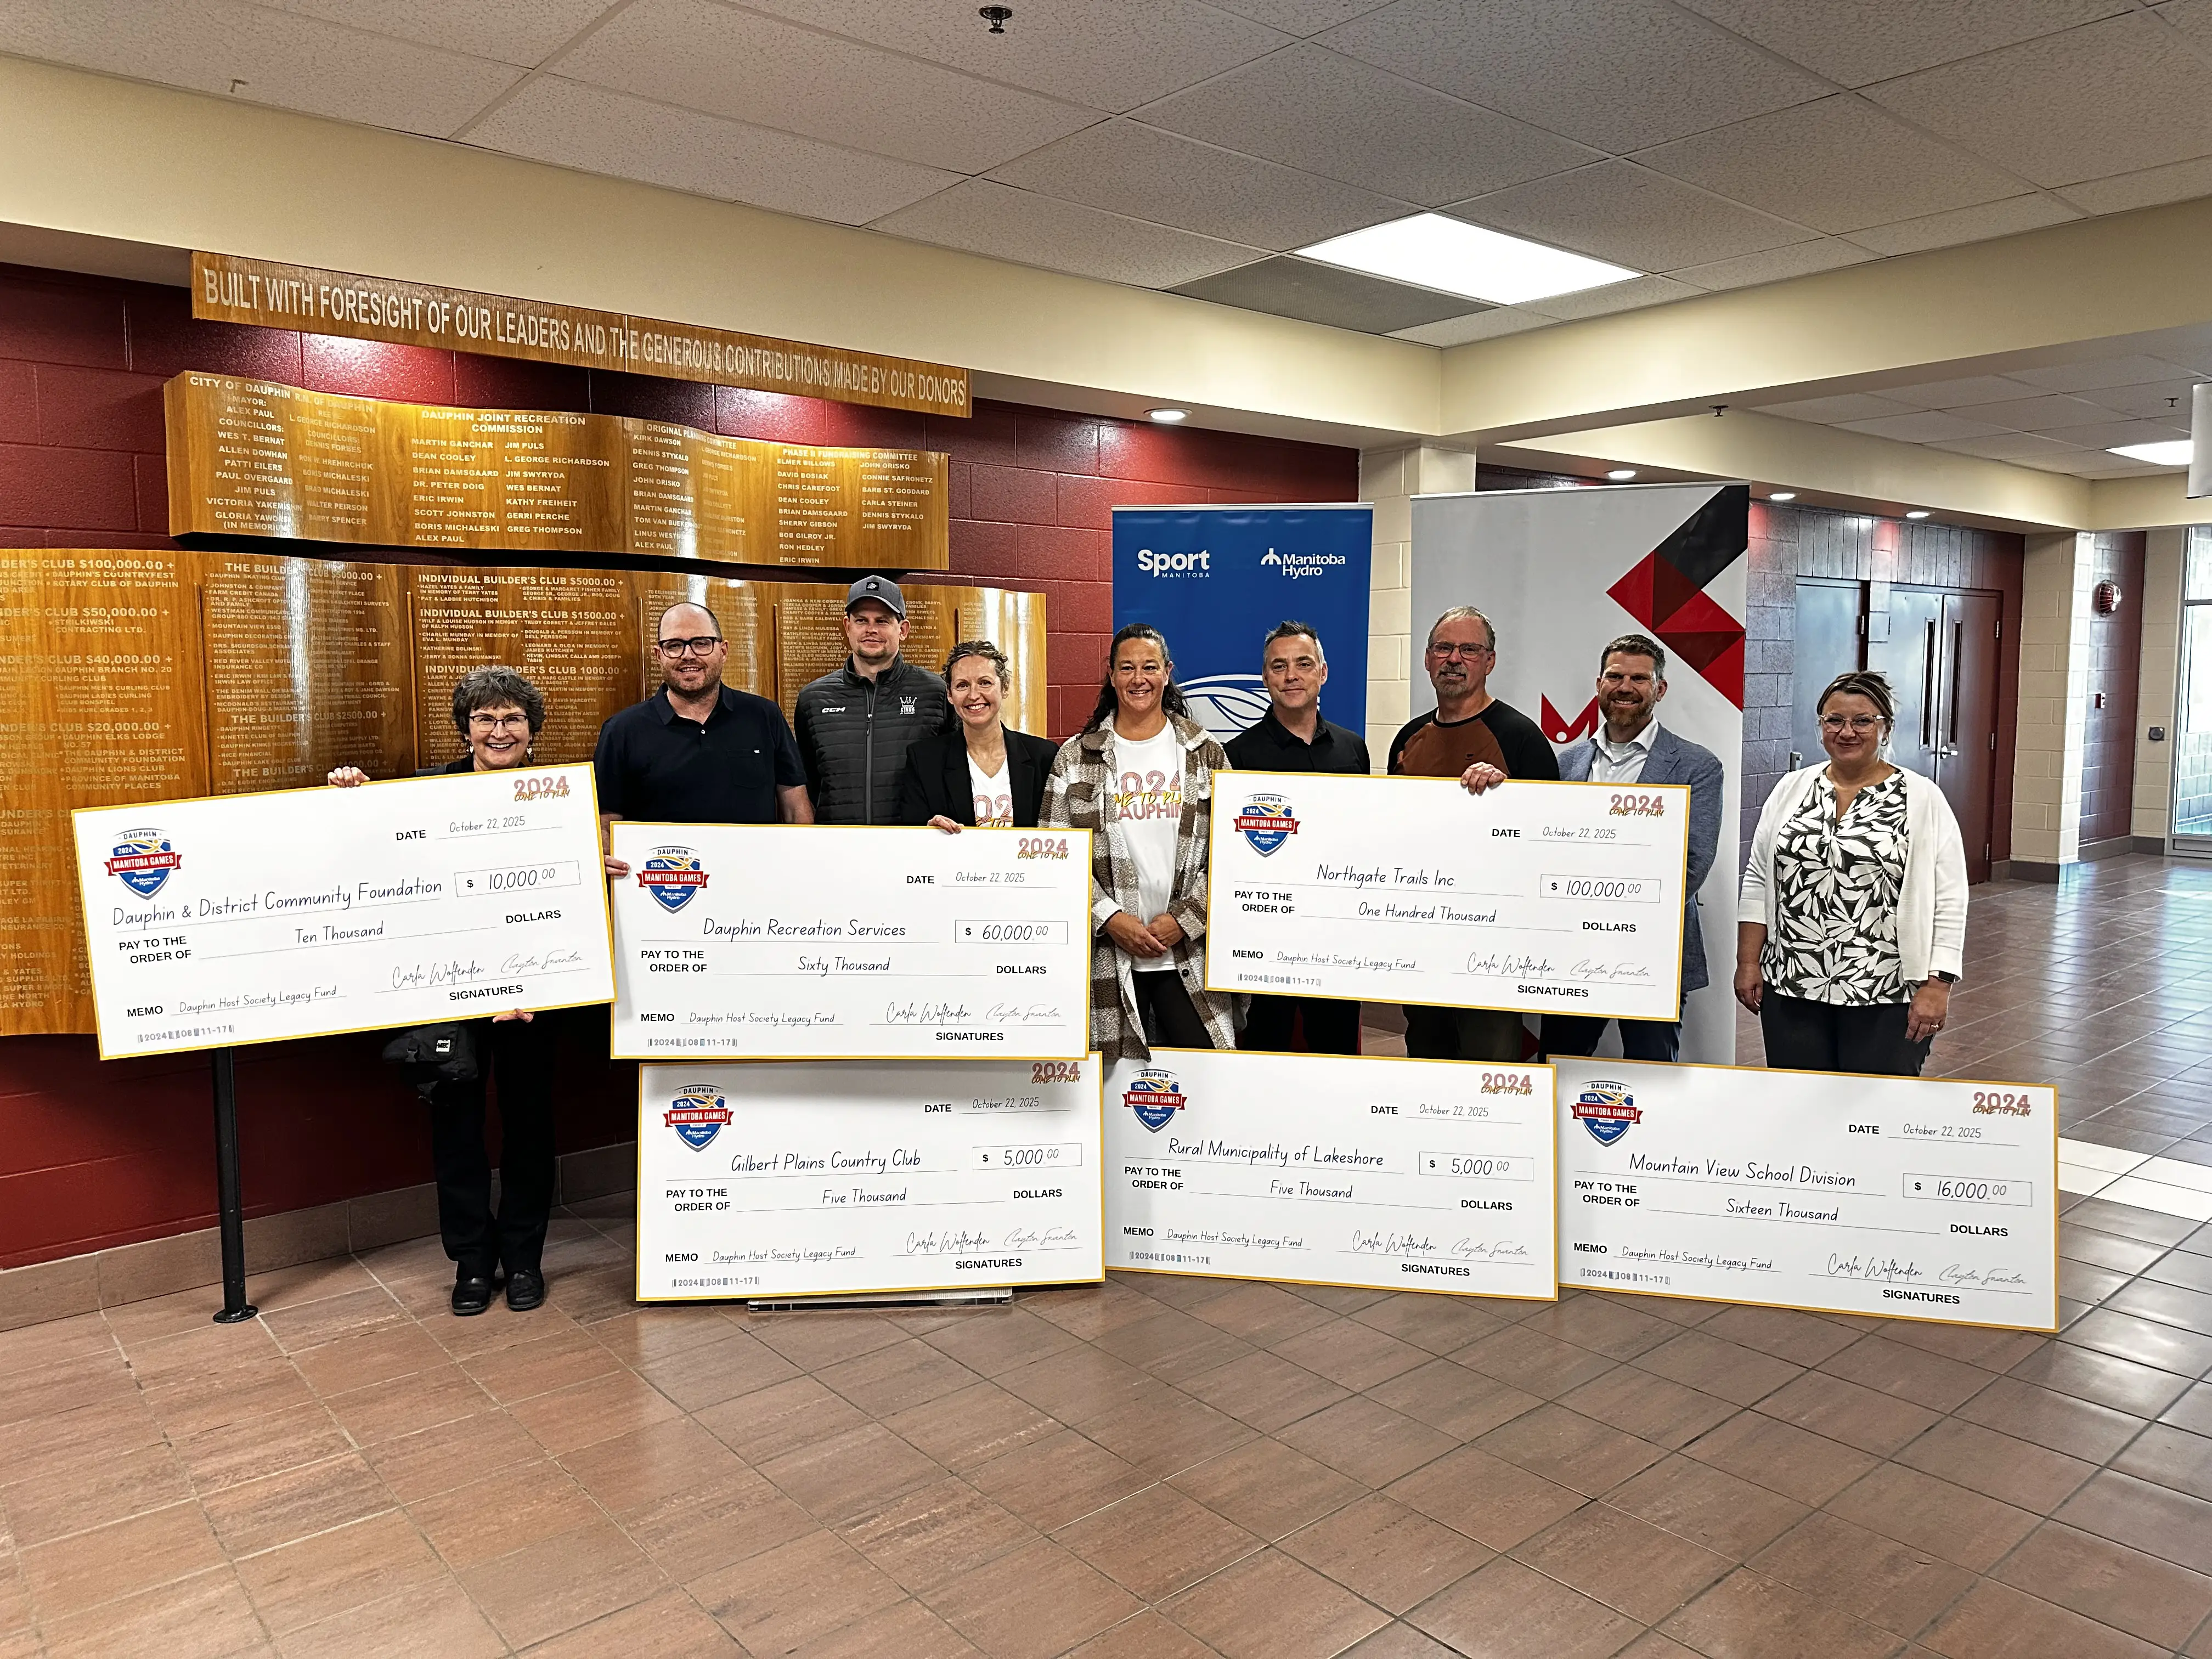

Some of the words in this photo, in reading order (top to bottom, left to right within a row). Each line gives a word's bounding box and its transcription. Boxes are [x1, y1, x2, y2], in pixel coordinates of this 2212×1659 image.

[204, 269, 260, 310] BUILT
[266, 276, 314, 317] WITH
[320, 285, 422, 330] FORESIGHT
[428, 301, 450, 334] OF
[455, 306, 491, 340] OUR
[496, 312, 569, 351] LEADERS
[574, 323, 605, 358] AND
[610, 326, 639, 360] THE
[643, 331, 721, 372] GENEROUS
[726, 343, 830, 387] CONTRIBUTIONS
[833, 362, 868, 392] MADE
[872, 366, 887, 394] BY
[890, 369, 915, 399] OUR
[918, 374, 965, 407] DONORS
[190, 376, 221, 388] CITY
[225, 381, 241, 390] OF
[246, 383, 290, 398] DAUPHIN
[226, 405, 251, 415] ALEX
[253, 409, 275, 419] PAUL
[421, 410, 474, 421] DAUPHIN
[477, 414, 511, 422] JOINT
[514, 414, 586, 425] RECREATION
[219, 418, 284, 432] COUNCILLORS:
[471, 424, 543, 433] COMMISSION
[218, 431, 239, 439] WES
[253, 435, 285, 445] BERNAT
[411, 438, 447, 447] MARTIN
[818, 450, 871, 459] FUNDRAISING
[873, 452, 918, 461] COMMITTEE
[224, 460, 251, 468] PATTI
[254, 462, 283, 471] EILERS
[656, 465, 689, 475] THOMPSON
[656, 479, 680, 487] ORISKO
[253, 487, 275, 496] PULS
[42, 560, 75, 568] CLUB
[80, 560, 163, 570] $100,000.00
[1138, 549, 1210, 578] Sport
[1283, 554, 1345, 565] Manitoba
[1283, 565, 1322, 579] Hydro
[418, 575, 481, 584] INDIVIDUAL
[484, 576, 537, 584] BUILDER'S
[570, 578, 615, 586] $5000.00
[45, 608, 78, 616] CLUB
[83, 608, 157, 618] $50,000.00
[420, 609, 482, 618] INDIVIDUAL
[485, 610, 538, 618] BUILDER'S
[1141, 793, 1156, 805] TO
[112, 857, 148, 870] MANITOBA
[149, 853, 174, 867] GAMES
[1317, 864, 1386, 889] Northgate
[1394, 868, 1428, 884] Trails
[1234, 891, 1252, 900] PAY
[1255, 891, 1269, 900] TO
[114, 904, 174, 930] Dauphin
[182, 905, 191, 918] &
[200, 894, 258, 916] District
[266, 885, 350, 910] Community
[359, 877, 441, 900] Foundation
[1242, 904, 1277, 913] ORDER
[506, 910, 561, 923] DOLLARS
[1359, 902, 1380, 916] One
[1386, 904, 1435, 918] Hundred
[1441, 906, 1496, 922] Thousand
[295, 929, 317, 943] Ten
[323, 921, 383, 940] Thousand
[703, 918, 760, 941] Dauphin
[768, 919, 841, 935] Recreation
[848, 919, 905, 935] Services
[798, 956, 828, 977] Sixty
[835, 957, 890, 970] Thousand
[1482, 1073, 1532, 1090] 2024
[973, 1098, 1002, 1108] October
[1019, 1097, 1039, 1107] 2025
[1169, 1138, 1203, 1155] Rural
[1209, 1140, 1288, 1167] Municipality
[1295, 1146, 1310, 1160] of
[1314, 1146, 1383, 1165] Lakeshore
[732, 1154, 778, 1171] Gilbert
[784, 1154, 825, 1170] Plains
[832, 1151, 885, 1174] Country
[893, 1149, 920, 1166] Club
[1630, 1153, 1698, 1174] Mountain
[1707, 1159, 1739, 1177] View
[1746, 1163, 1794, 1181] School
[1800, 1166, 1855, 1186] Division
[823, 1190, 846, 1204] Five
[853, 1187, 906, 1202] Thousand
[1271, 1180, 1293, 1194] Five
[1300, 1182, 1352, 1200] Thousand
[1726, 1199, 1771, 1215] Sixteen
[1779, 1203, 1838, 1221] Thousand
[666, 1254, 698, 1262] MEMO
[956, 1259, 1022, 1269] SIGNATURES
[1622, 1246, 1655, 1260] Dauphin
[1660, 1250, 1679, 1260] Host
[1682, 1252, 1712, 1267] Society
[1717, 1255, 1747, 1271] Legacy
[1751, 1258, 1772, 1268] Fund
